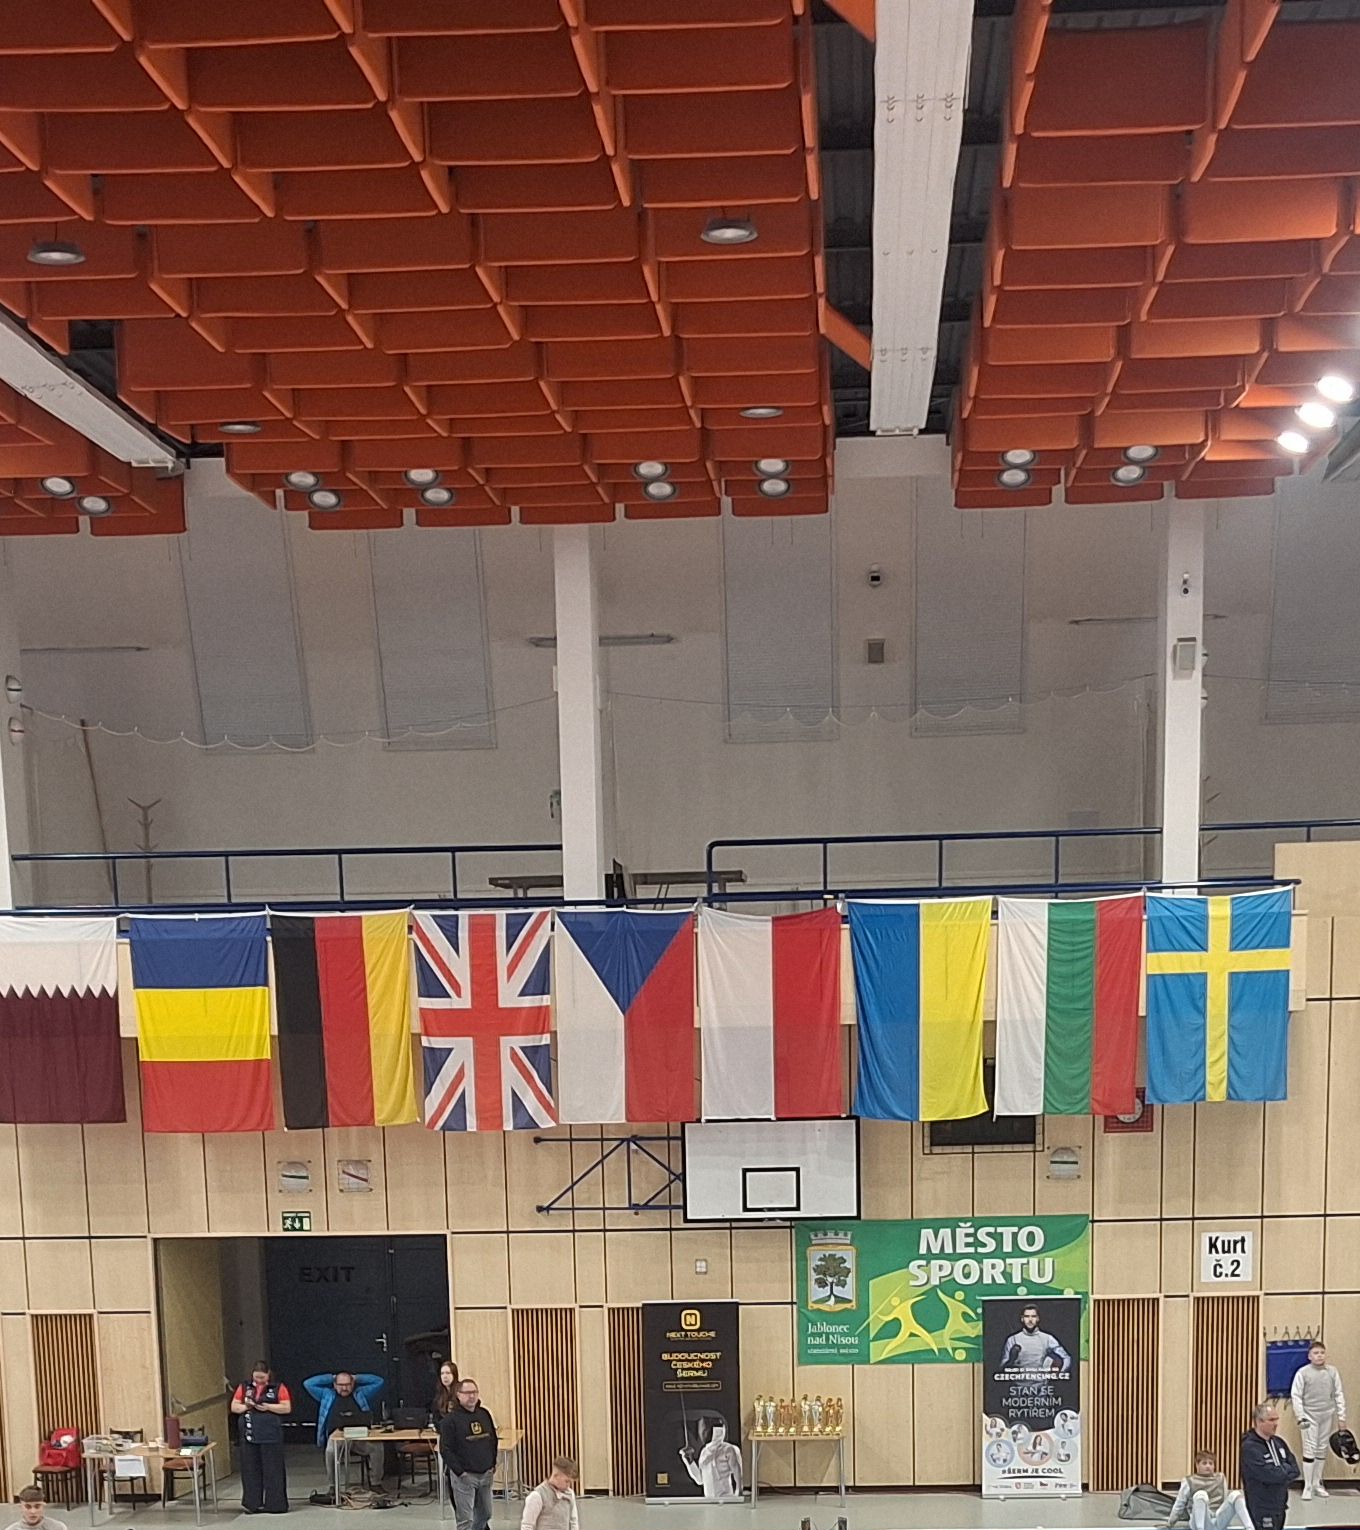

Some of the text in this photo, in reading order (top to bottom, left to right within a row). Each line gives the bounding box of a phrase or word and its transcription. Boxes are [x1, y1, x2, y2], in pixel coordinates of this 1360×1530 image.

[918, 1221, 1045, 1255] MĚSTO
[1208, 1235, 1246, 1255] Kurt
[908, 1257, 1054, 1287] SPORTU
[1213, 1258, 1241, 1278] č.2
[301, 1266, 355, 1283] EXIT
[807, 1322, 850, 1334] Jablonec
[807, 1334, 859, 1345] nad Nisou
[661, 1352, 722, 1361] BUDOUCNOST
[993, 1372, 1071, 1381] CZECHFENCING.CZ
[1039, 1385, 1055, 1396] SE
[1002, 1396, 1062, 1406] MODERNÍM
[1008, 1406, 1055, 1418] RYTÍŘEM
[1041, 1467, 1064, 1475] COOL
